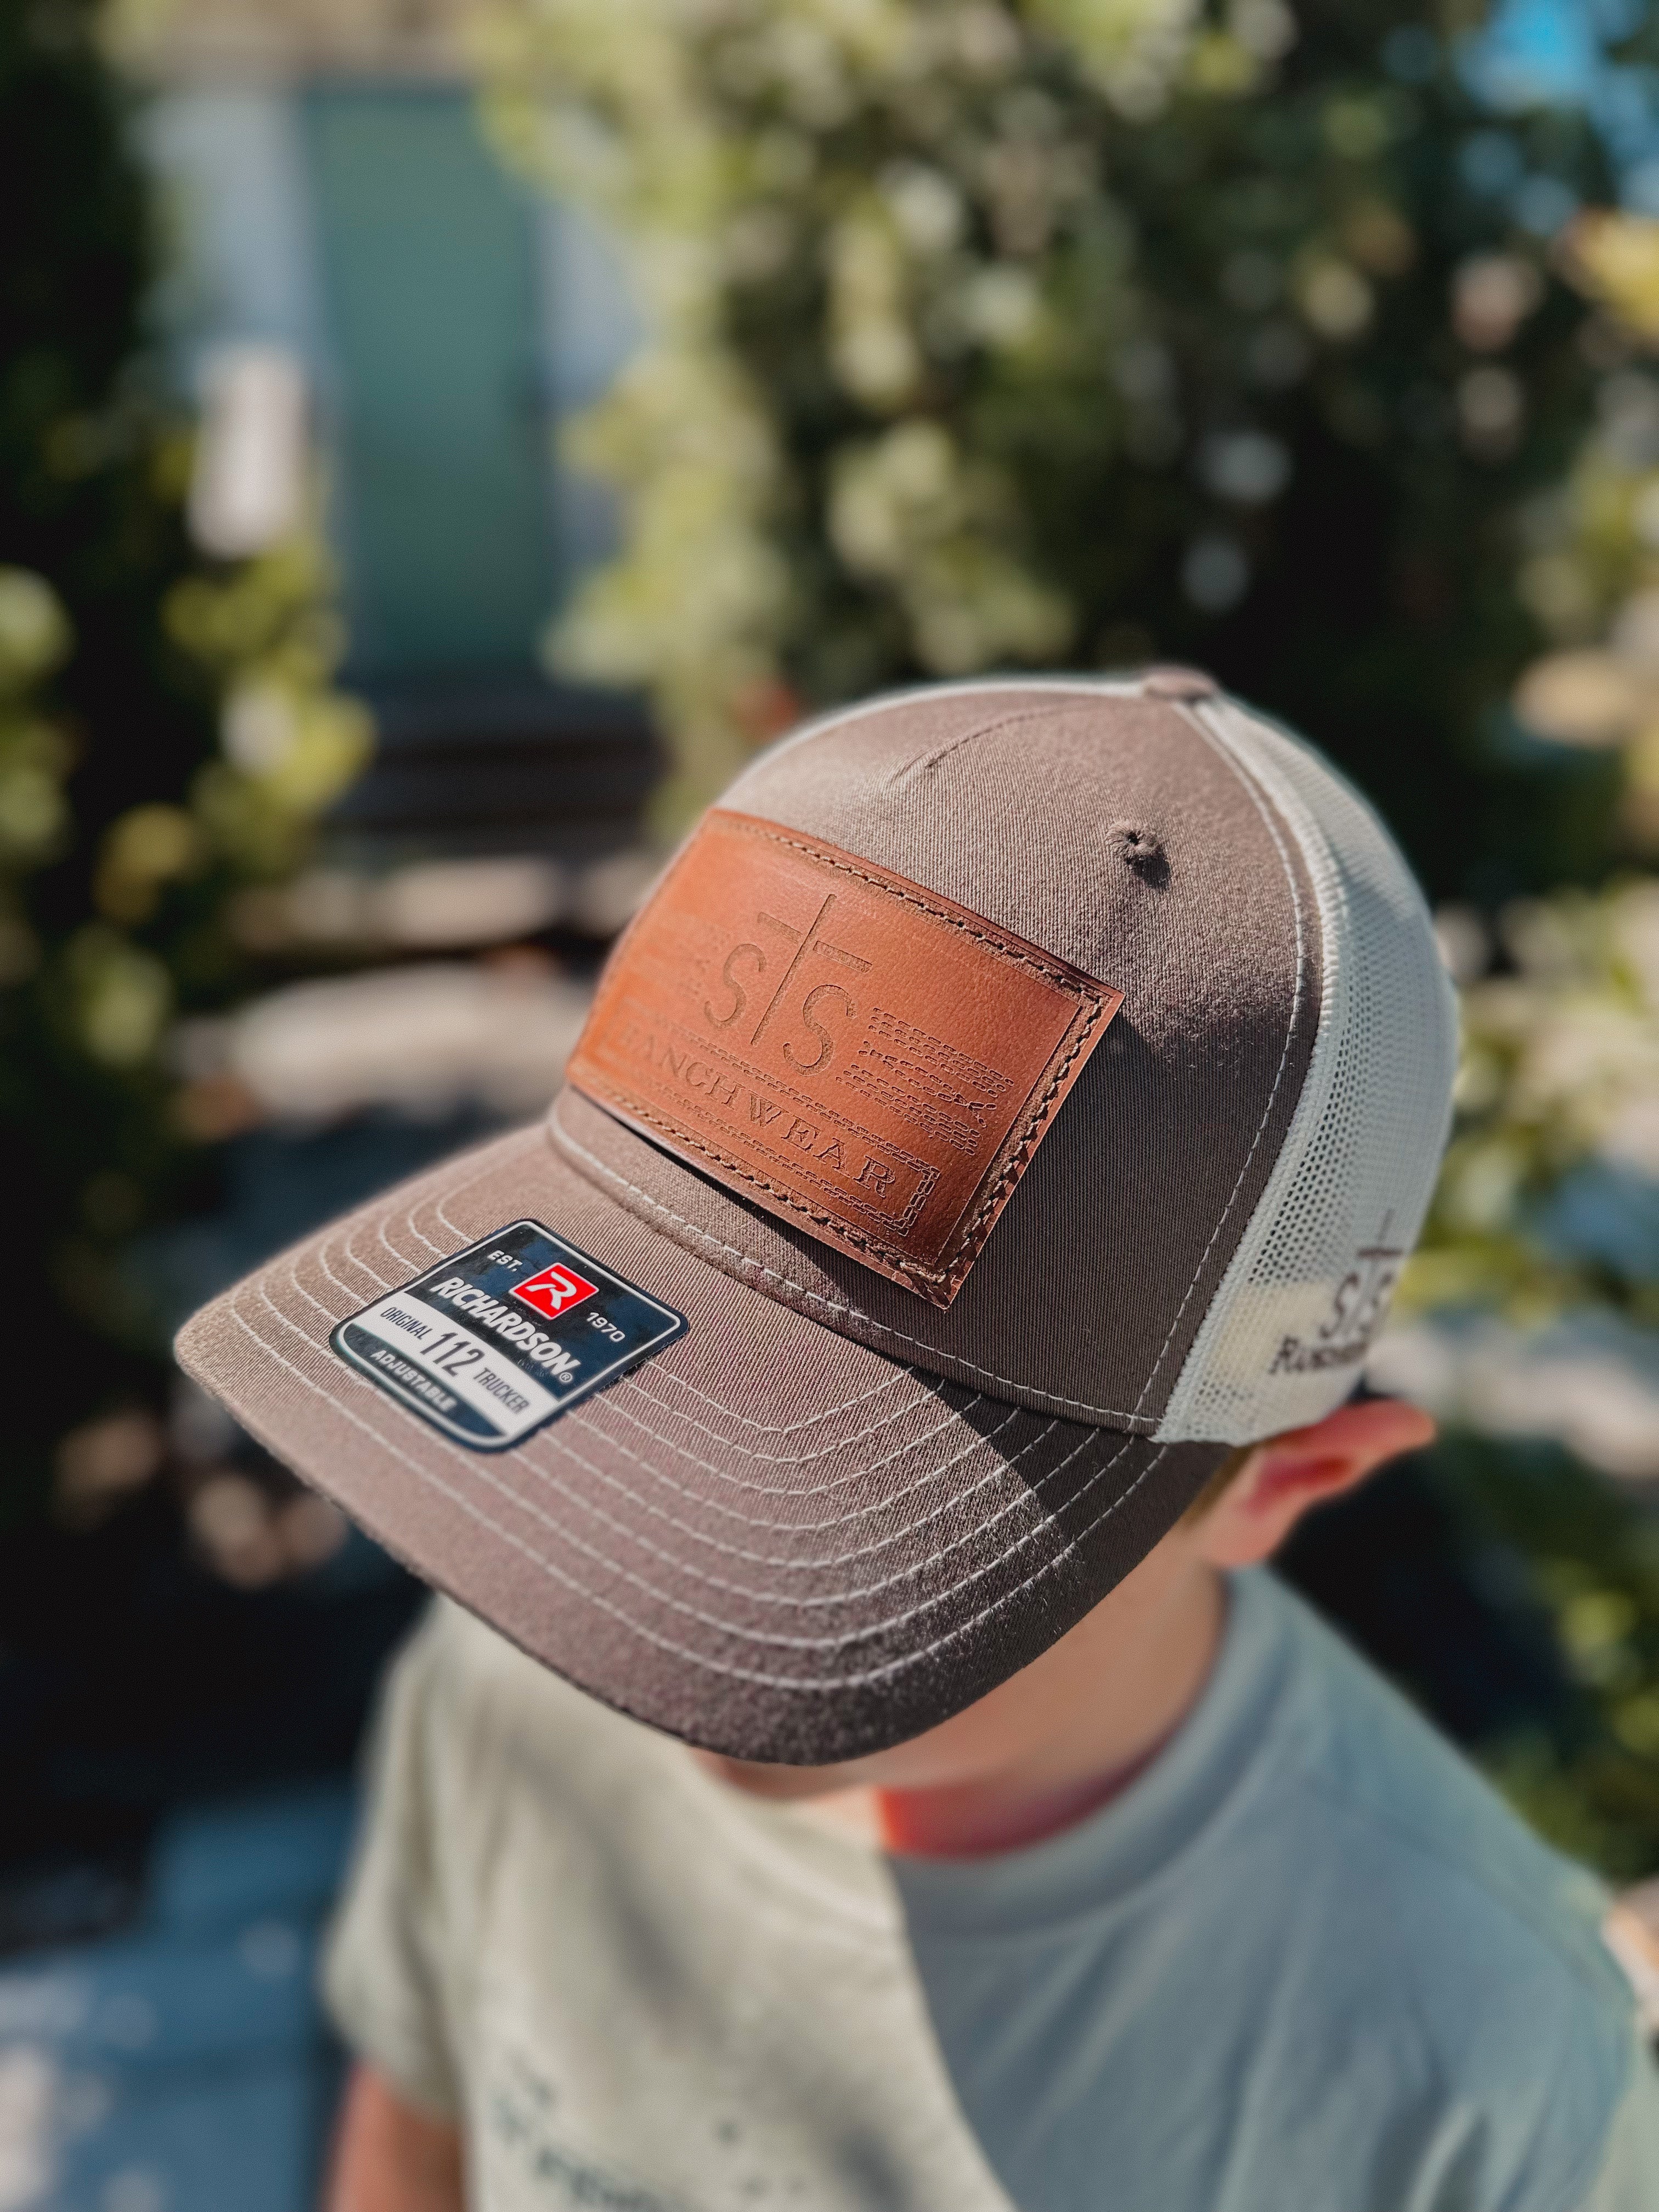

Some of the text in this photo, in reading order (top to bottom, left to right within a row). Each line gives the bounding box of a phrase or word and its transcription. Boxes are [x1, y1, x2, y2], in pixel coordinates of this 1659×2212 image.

[488, 1250, 523, 1272] EST.
[586, 1311, 626, 1342] 1970
[370, 1349, 458, 1413] ADJUSTABLE
[380, 1307, 531, 1415] ORIGINAL 112 TRUCKER
